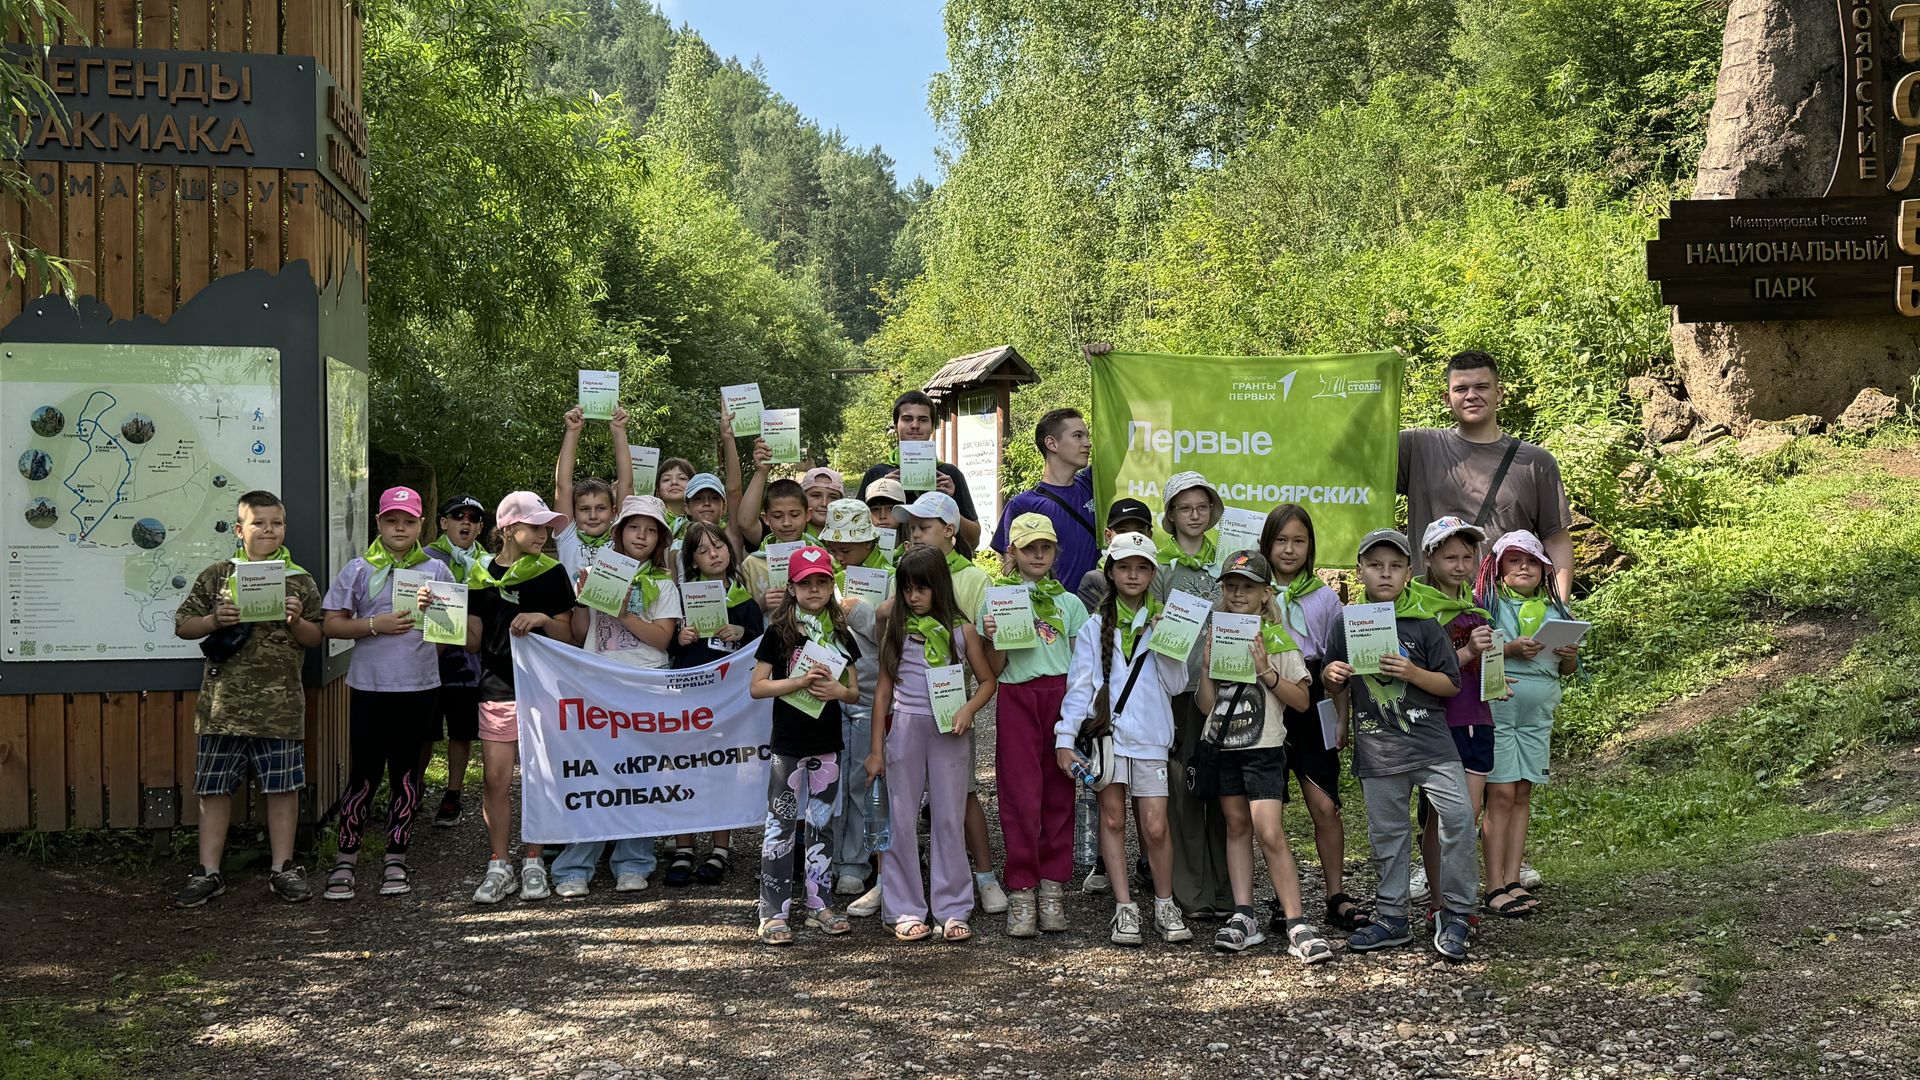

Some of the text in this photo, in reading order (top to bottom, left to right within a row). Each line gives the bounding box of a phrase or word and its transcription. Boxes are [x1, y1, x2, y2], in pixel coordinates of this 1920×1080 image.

[1852, 0, 1878, 180] ОЯРСКИЕ
[11, 109, 254, 154] ТАКМАКА
[35, 171, 309, 205] ОМАРШРУТ
[1729, 213, 1867, 230] Минприроды России
[1686, 234, 1889, 266] НАЦИОНАЛЬНЫЙ
[1755, 277, 1817, 299] ПАРК
[1229, 393, 1276, 401] ПЕРВЫХ
[1232, 382, 1276, 390] ГРАНТЫ
[1347, 383, 1381, 391] СТОЛБЫ
[1128, 420, 1272, 464] Первые
[1128, 479, 1370, 505] НА АСНОЯРСКИХ
[666, 679, 715, 690] ПЕРВЫХ
[669, 673, 715, 683] ГРАНТЫ
[559, 698, 714, 739] Первые
[562, 744, 772, 778] НА «КРАСНОЯРС
[565, 784, 696, 811] СТОЛБАХ»
